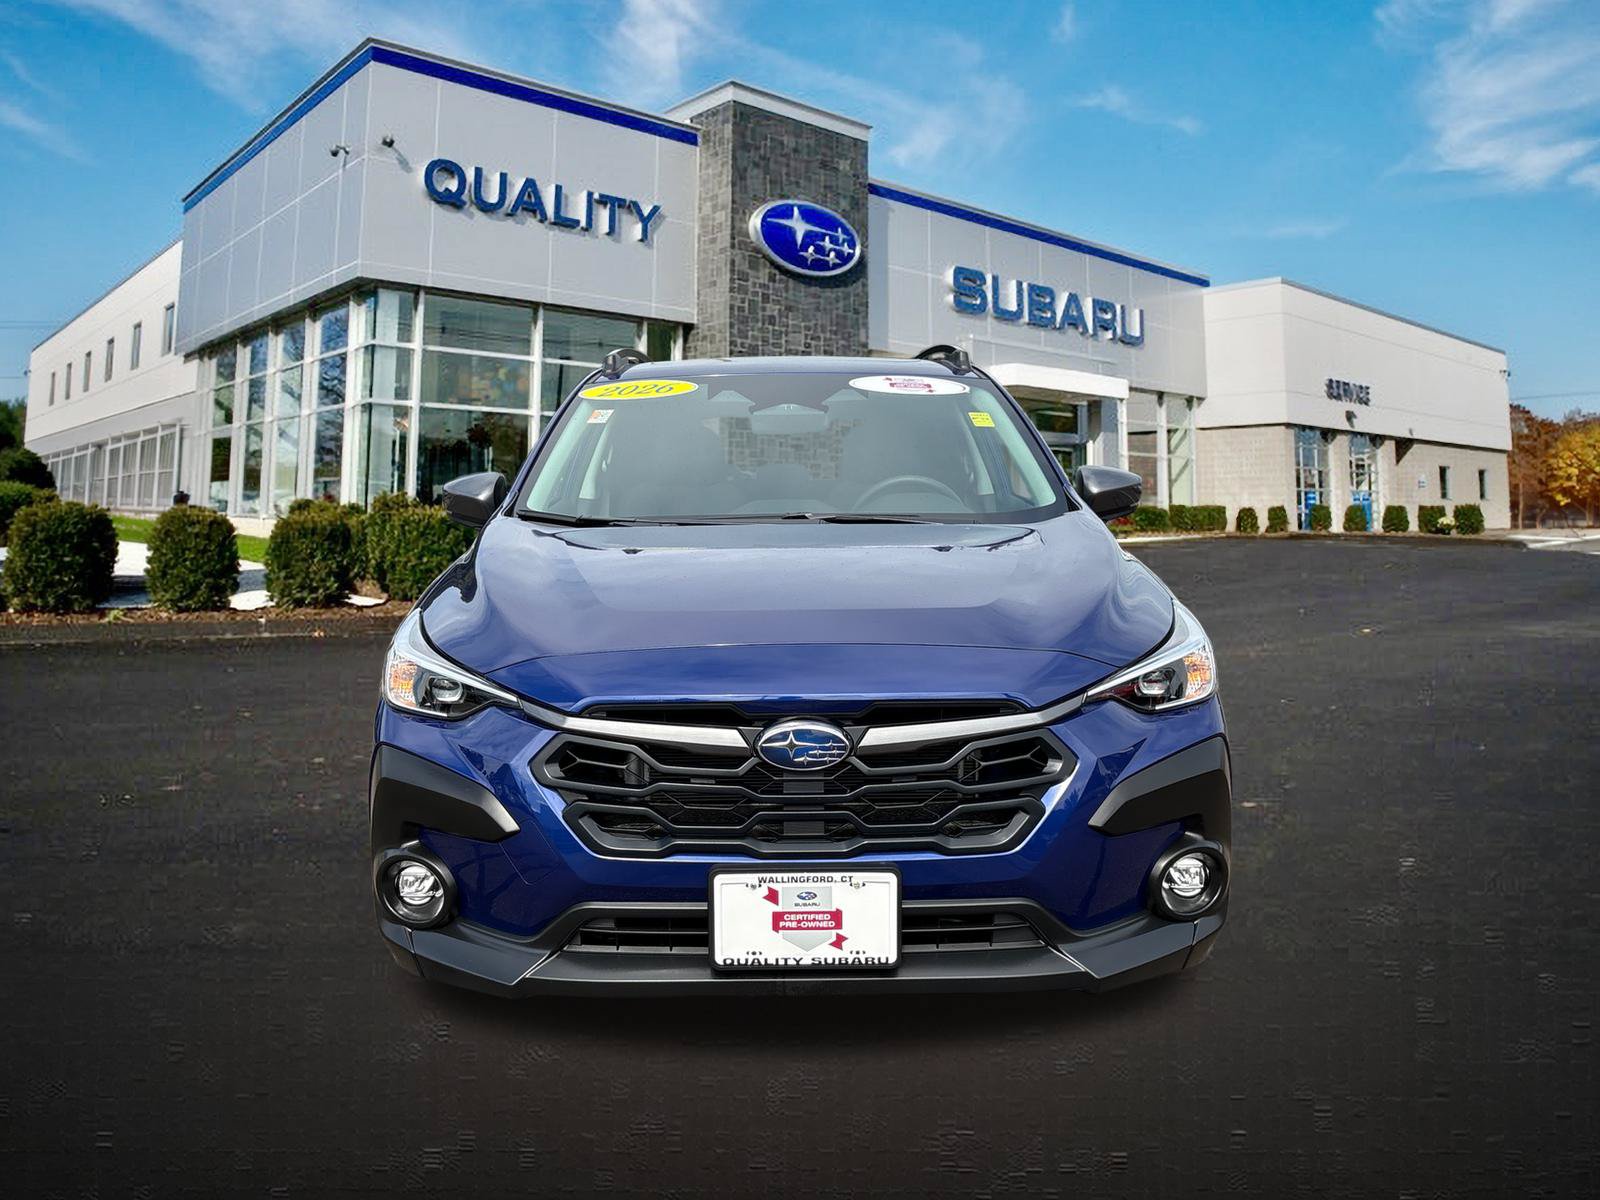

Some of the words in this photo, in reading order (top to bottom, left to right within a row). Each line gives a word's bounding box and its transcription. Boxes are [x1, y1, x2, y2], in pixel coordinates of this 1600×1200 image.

[424, 158, 662, 243] QUALITY
[951, 266, 1146, 346] SUBARU
[597, 382, 676, 398] 2026
[840, 875, 854, 883] CT
[783, 913, 831, 921] CERTIFIED
[779, 920, 836, 928] PRE-OWNED
[722, 957, 804, 966] QUALITY
[811, 956, 889, 965] SUBARU
